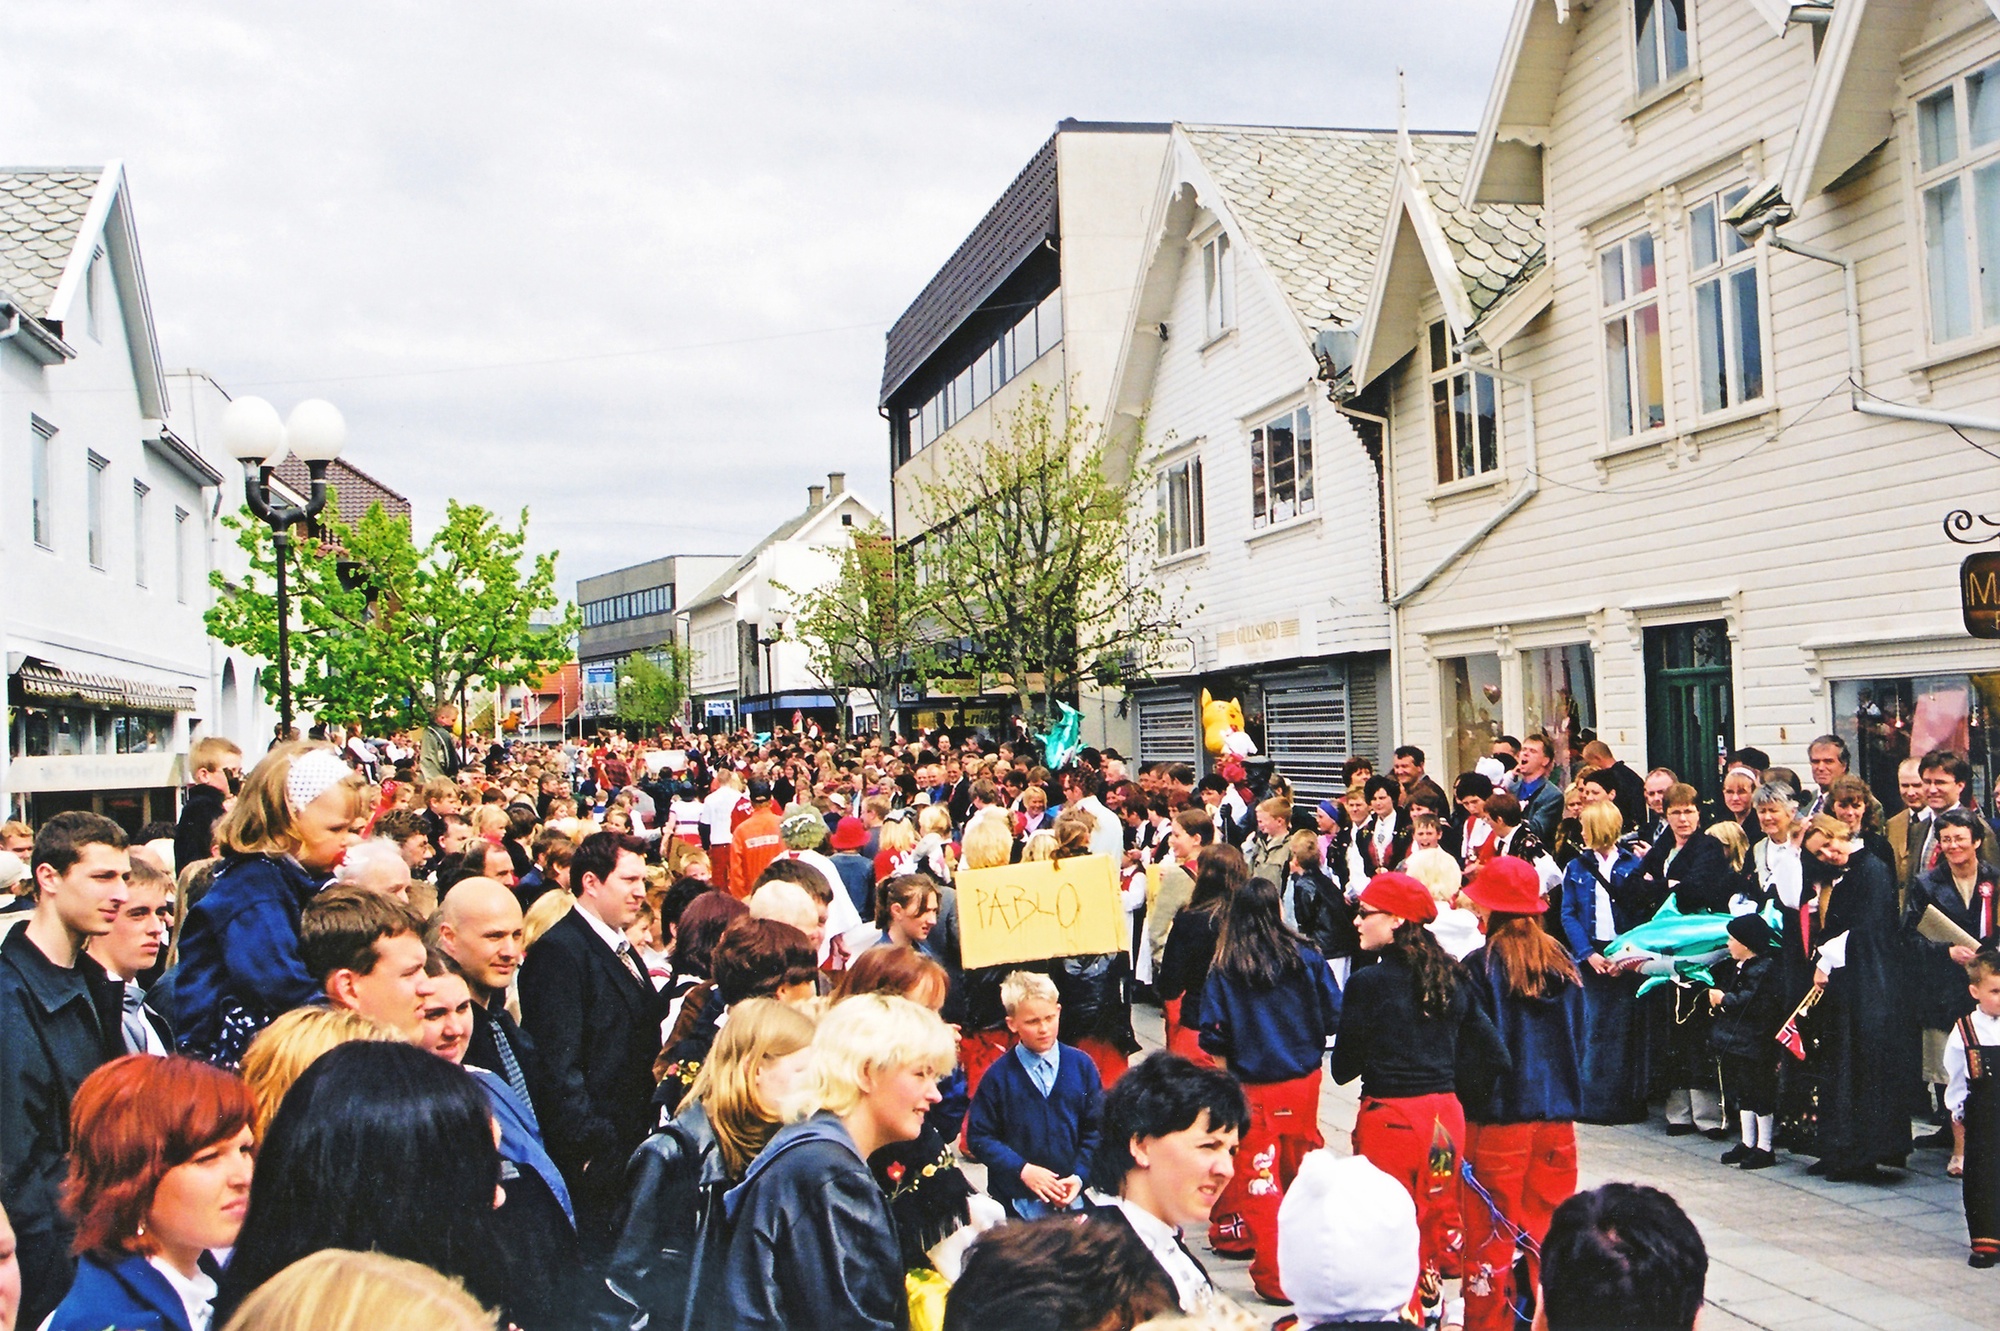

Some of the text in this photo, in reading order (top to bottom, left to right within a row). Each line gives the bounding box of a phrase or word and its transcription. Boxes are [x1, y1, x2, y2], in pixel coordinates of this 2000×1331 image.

[1237, 621, 1279, 644] GULLSMED
[71, 764, 153, 778] Telenor
[976, 882, 1081, 934] PABLO
